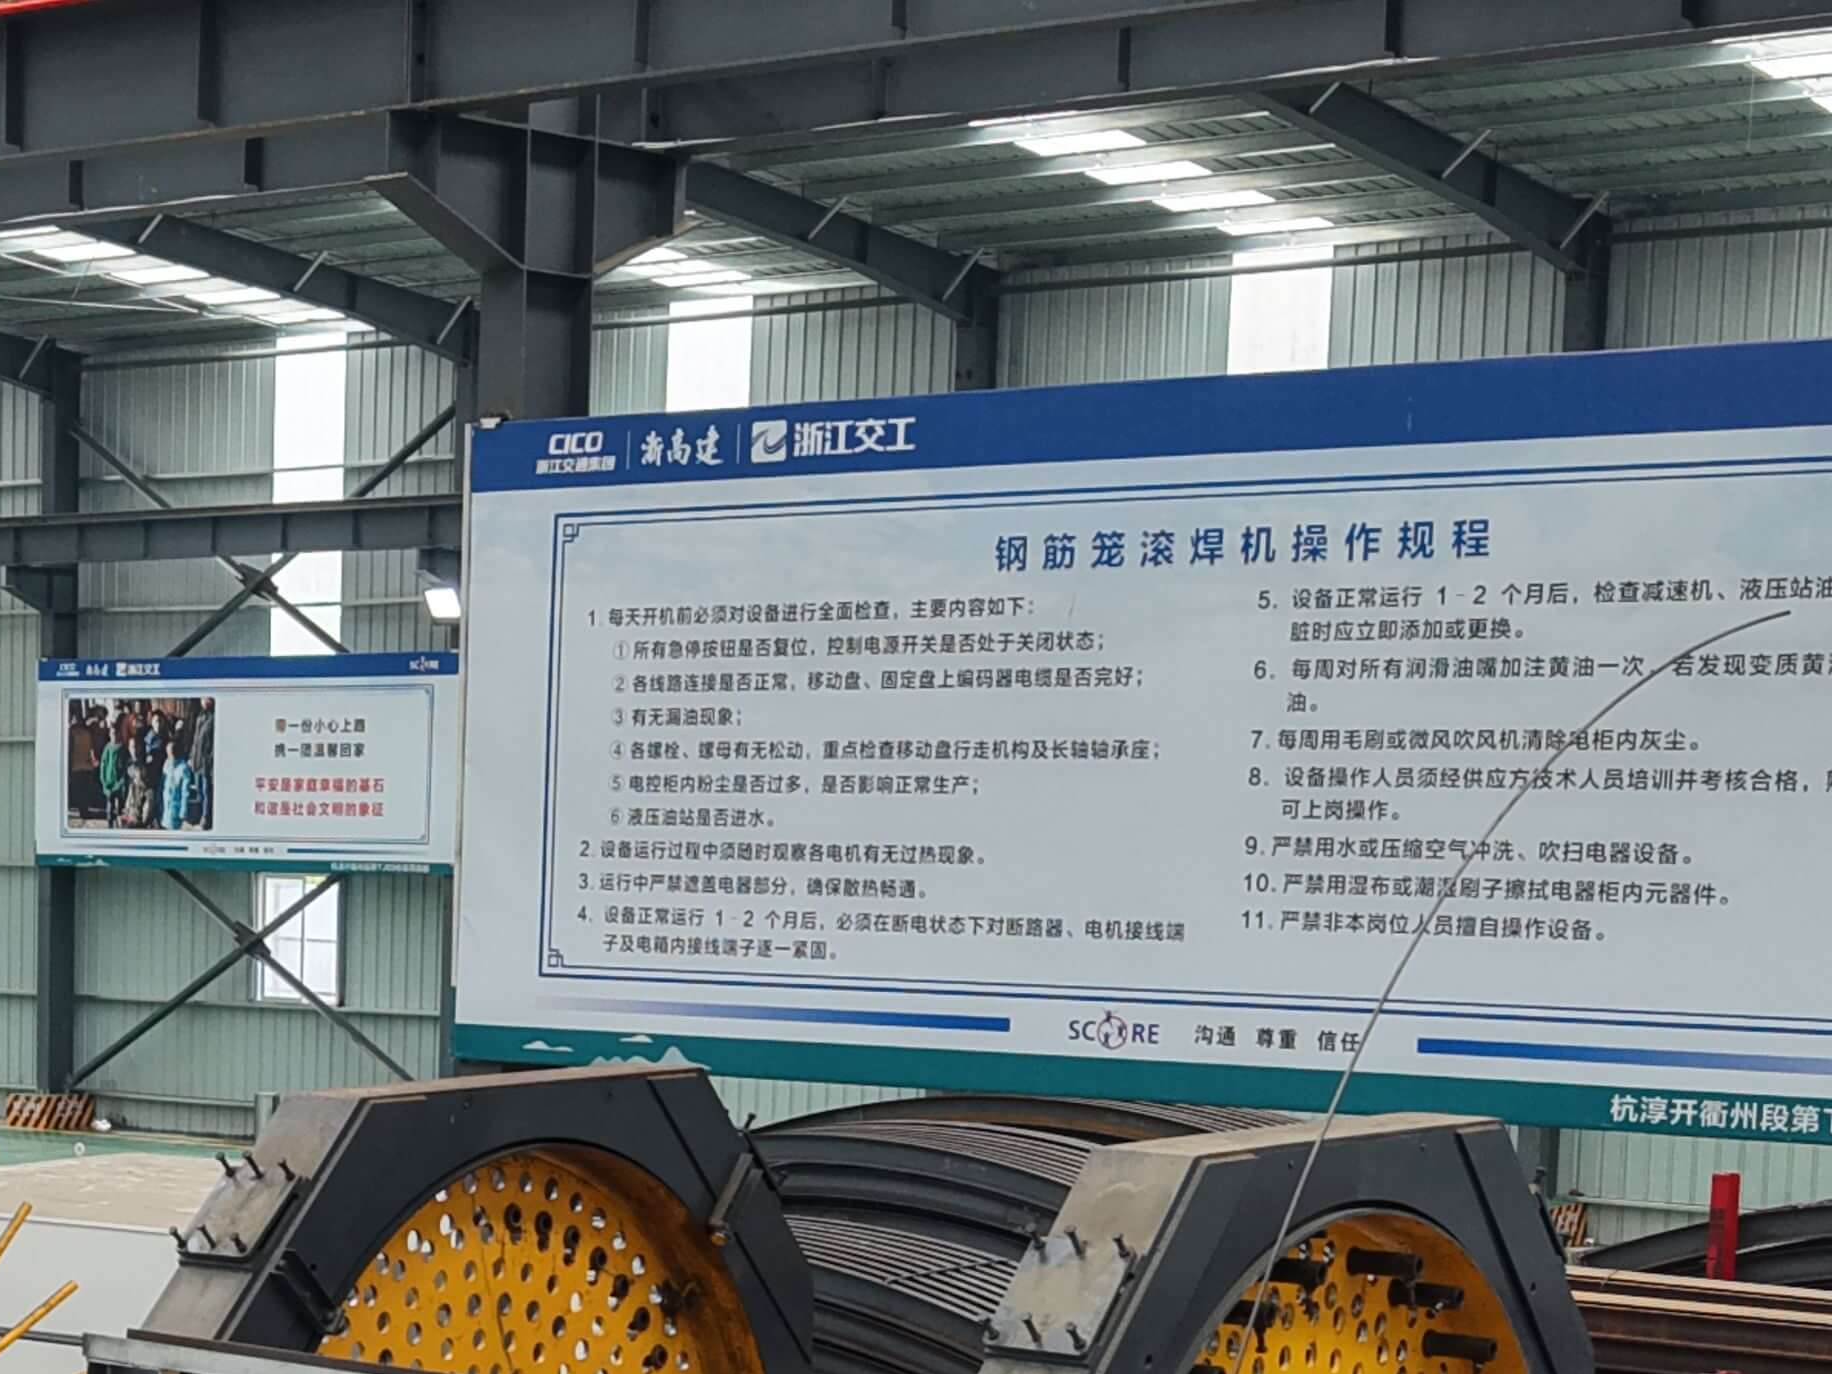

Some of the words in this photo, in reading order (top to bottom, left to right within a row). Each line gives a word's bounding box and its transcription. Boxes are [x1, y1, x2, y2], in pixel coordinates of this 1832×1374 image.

[548, 431, 604, 455] CICO
[793, 416, 916, 457] 浙江交工
[995, 518, 1491, 573] 钢筋笼滚焊机操作规程
[1282, 799, 1400, 821] 可上岗操作。
[1068, 1010, 1160, 1049] SCORE
[1195, 1024, 1236, 1046] 沟通
[1256, 1028, 1297, 1050] 尊重
[1318, 1030, 1361, 1053] 信任
